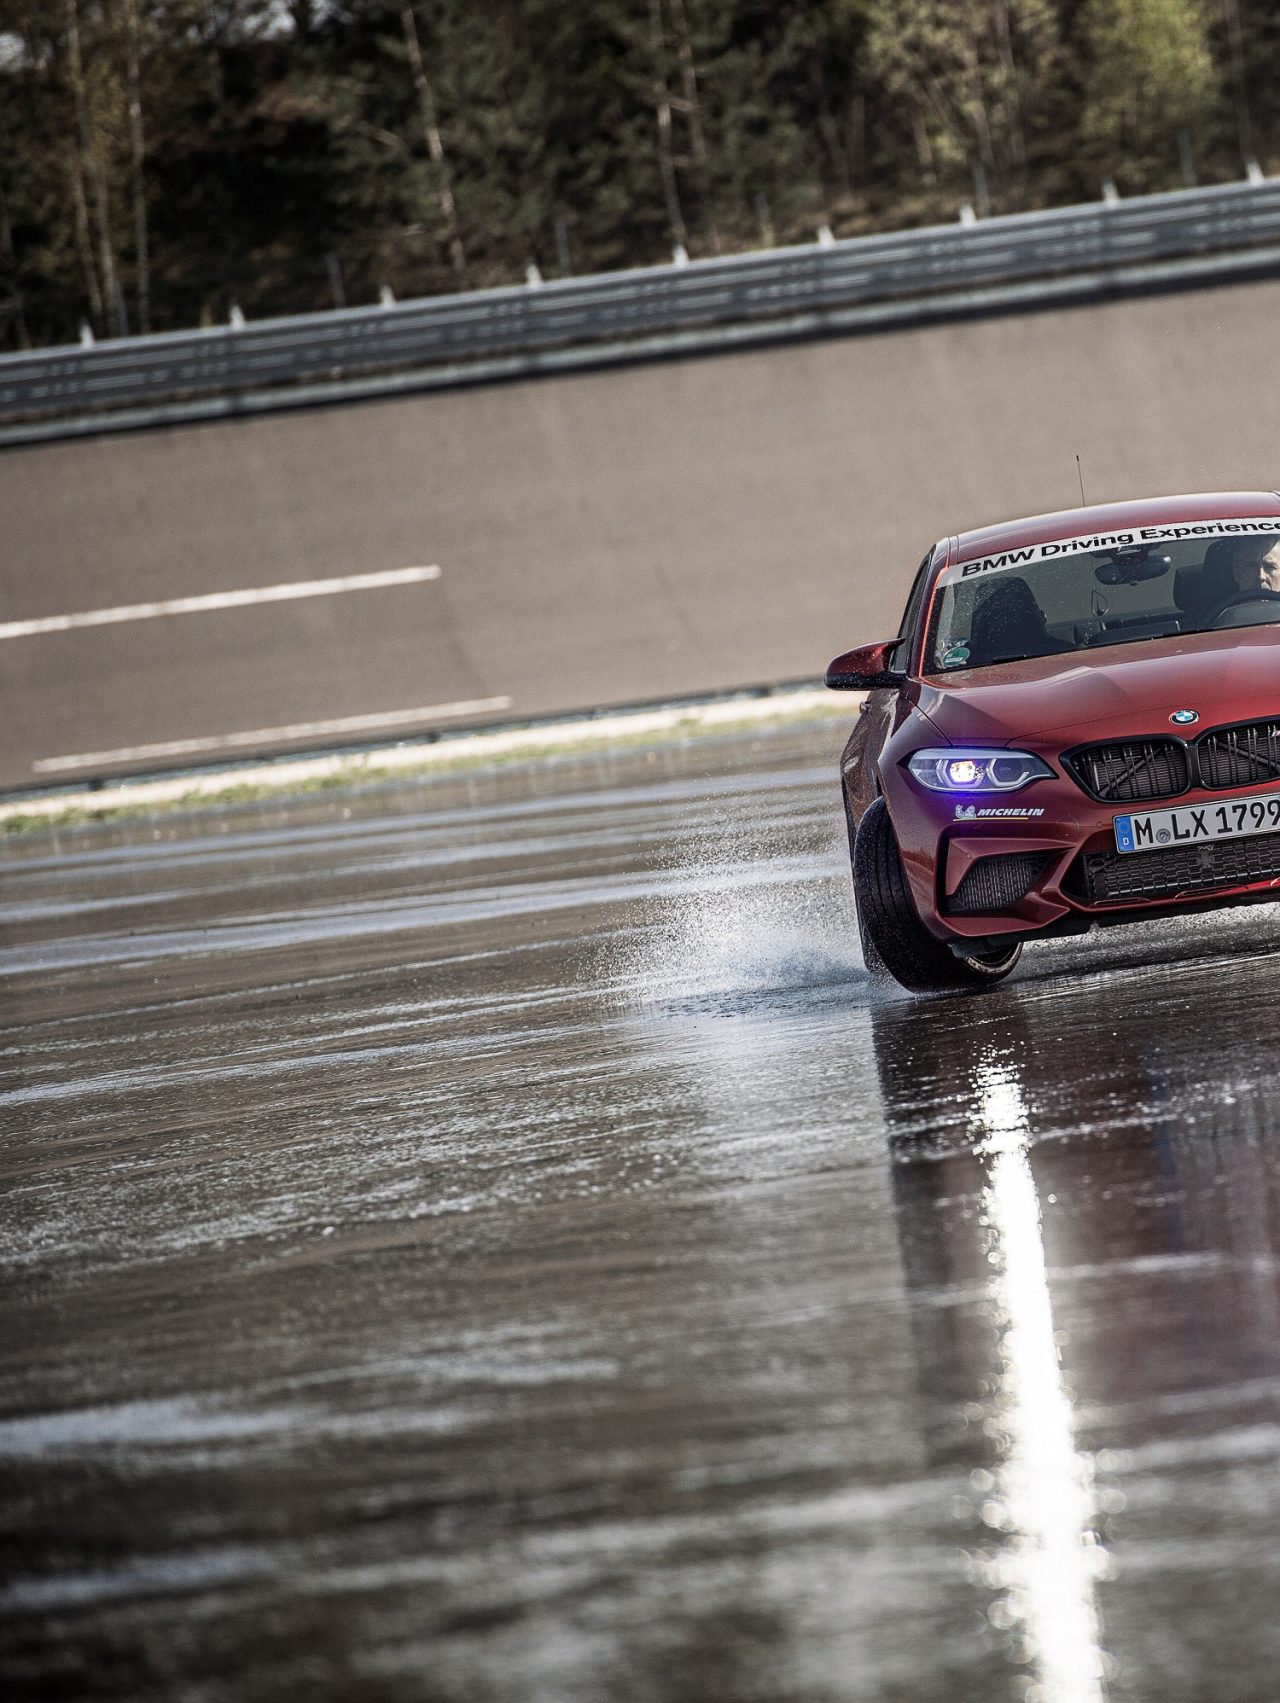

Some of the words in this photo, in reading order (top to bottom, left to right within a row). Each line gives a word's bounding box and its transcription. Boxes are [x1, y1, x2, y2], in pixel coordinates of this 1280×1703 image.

[961, 548, 1035, 577] BMW
[1041, 531, 1135, 557] Driving
[977, 808, 1045, 816] MICHELIN
[1133, 817, 1154, 846] M
[1171, 809, 1209, 840] LX
[1122, 837, 1130, 846] D
